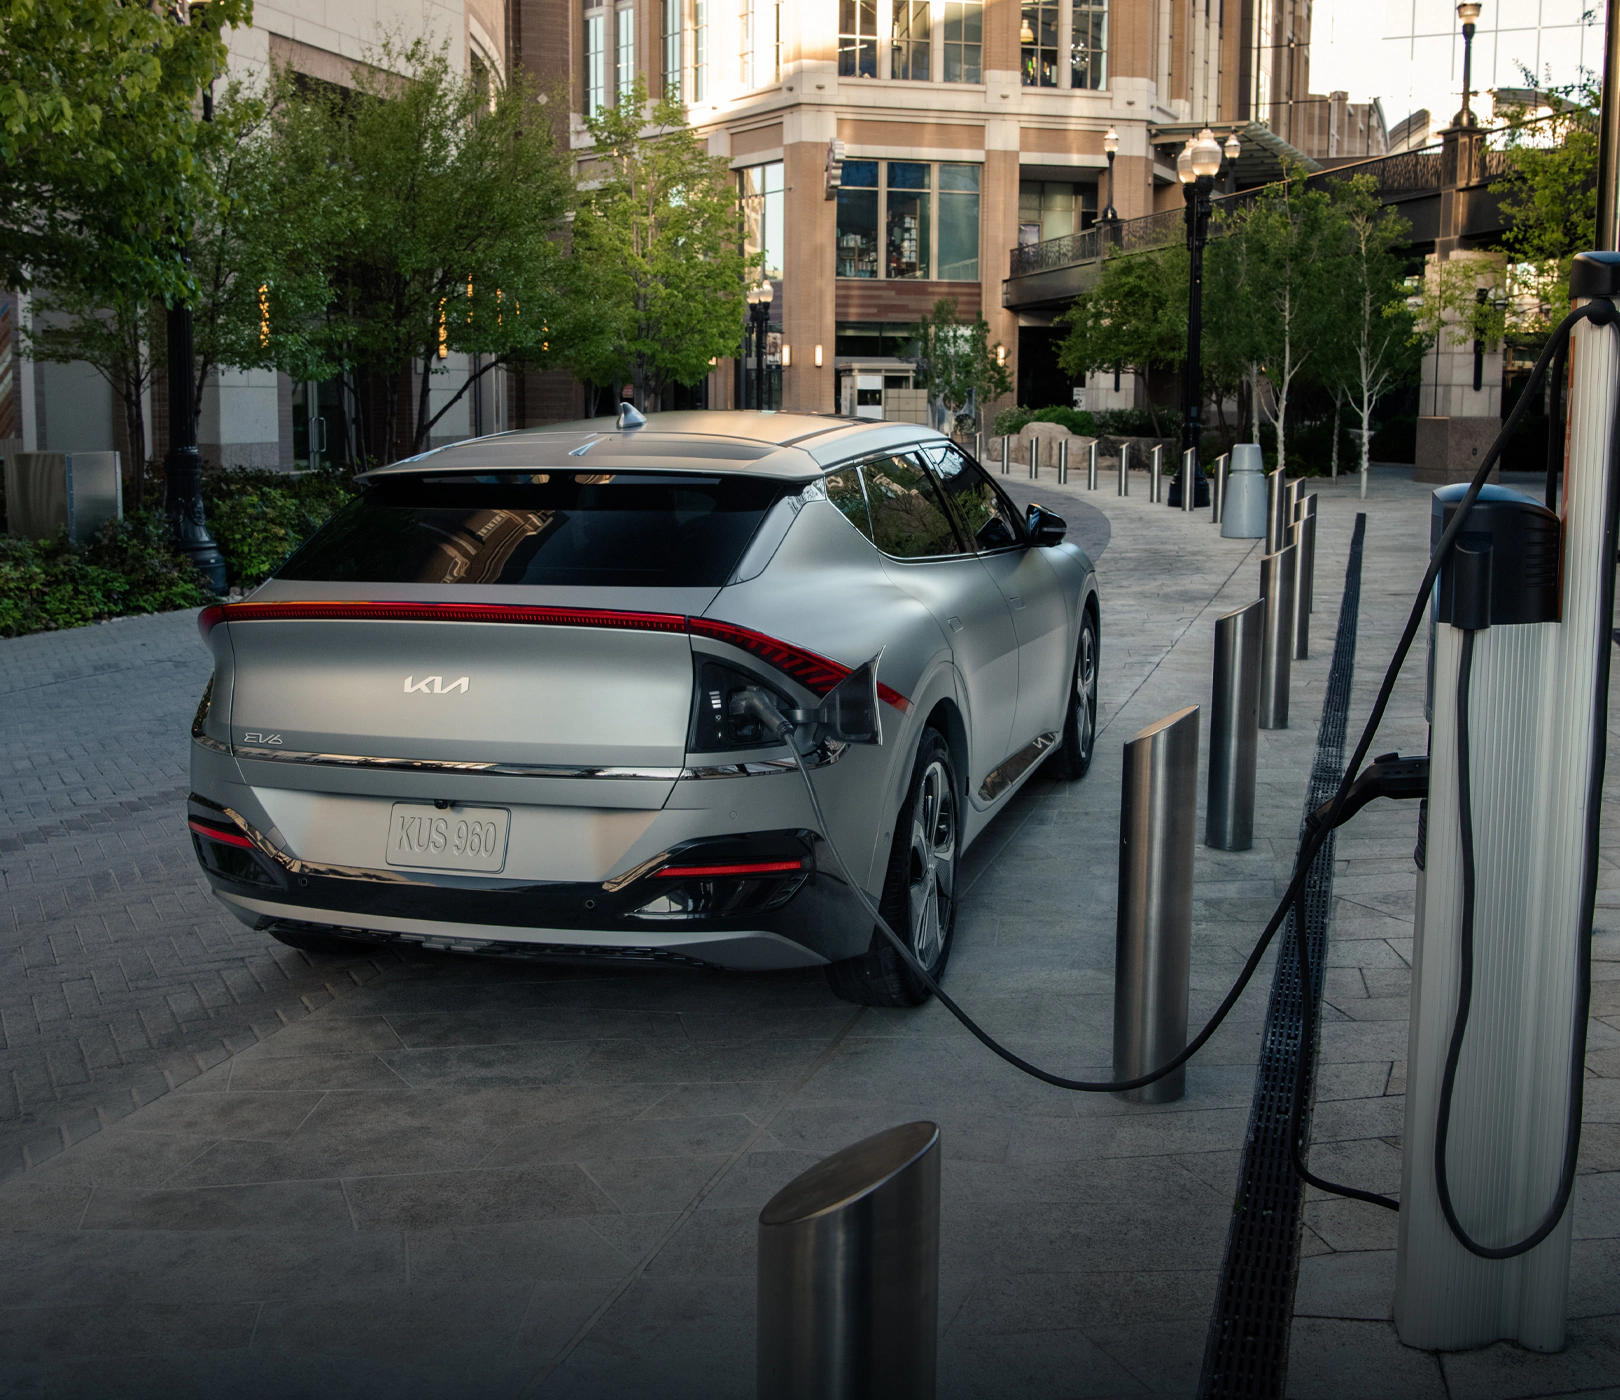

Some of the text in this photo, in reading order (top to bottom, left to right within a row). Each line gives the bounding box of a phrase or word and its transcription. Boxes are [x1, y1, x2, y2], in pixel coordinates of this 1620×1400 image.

[403, 675, 470, 694] KIA
[243, 732, 283, 745] EV6
[396, 816, 497, 858] KUS 960
